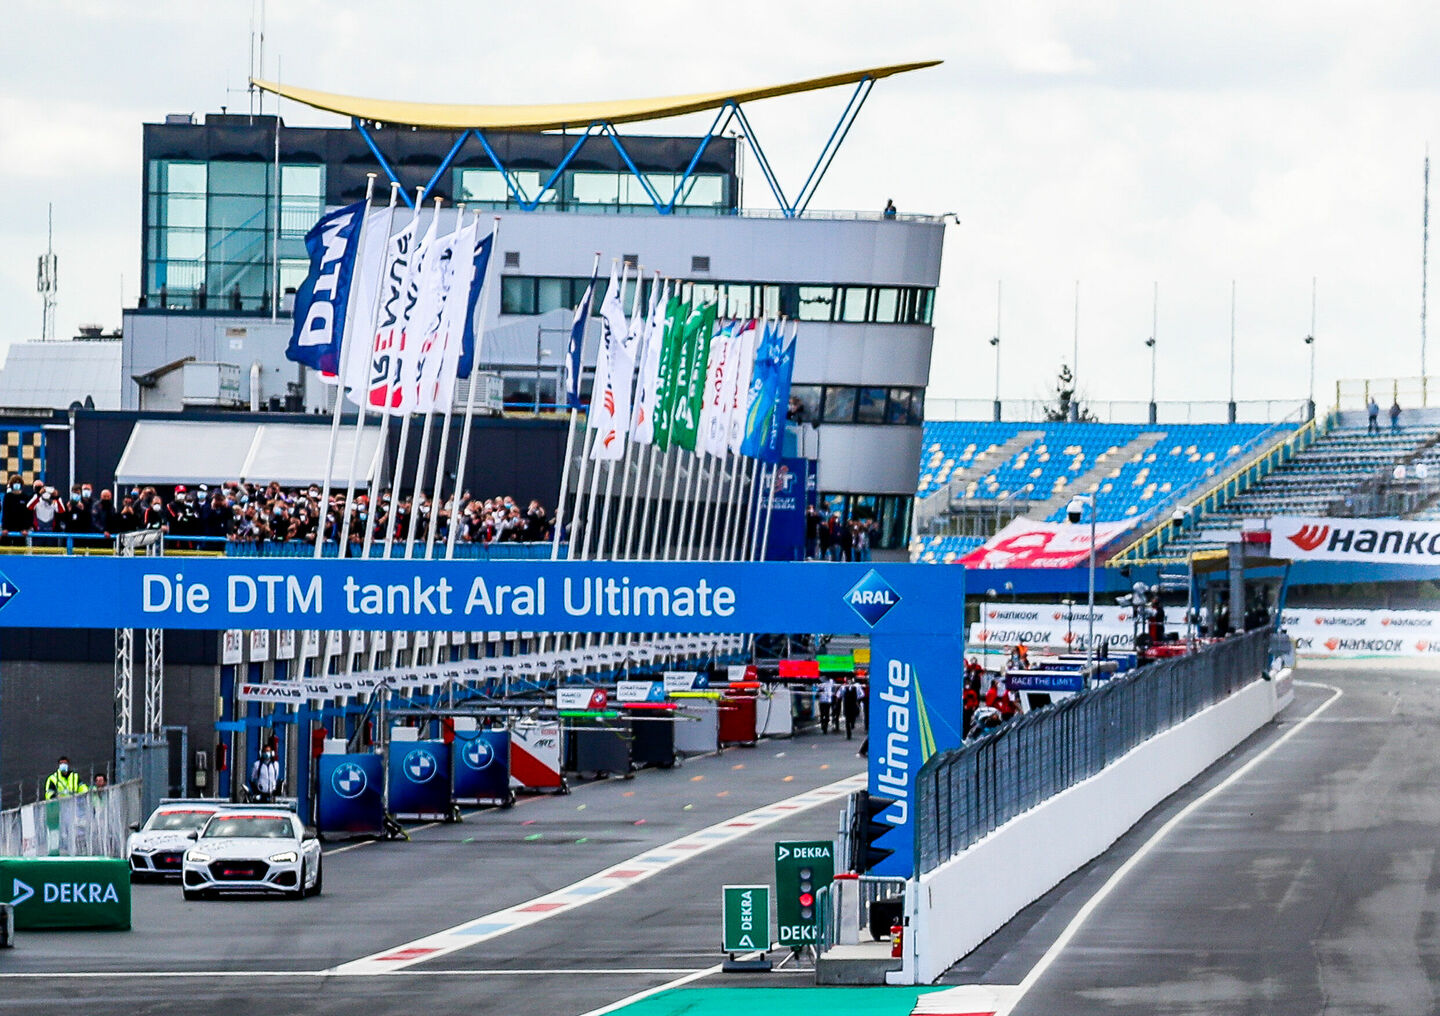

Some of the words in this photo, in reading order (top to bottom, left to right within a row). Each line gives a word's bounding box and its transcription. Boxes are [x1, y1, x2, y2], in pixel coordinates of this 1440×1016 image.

[297, 212, 355, 347] DTM
[142, 573, 210, 614] Die
[227, 574, 323, 614] DTM
[343, 575, 453, 616] tankt
[464, 576, 545, 616] Aral
[564, 577, 737, 617] Ultimate
[850, 589, 894, 606] ARAL
[794, 847, 831, 859] DEKRA
[43, 882, 119, 904] DEKRA
[741, 890, 753, 931] DEKRA
